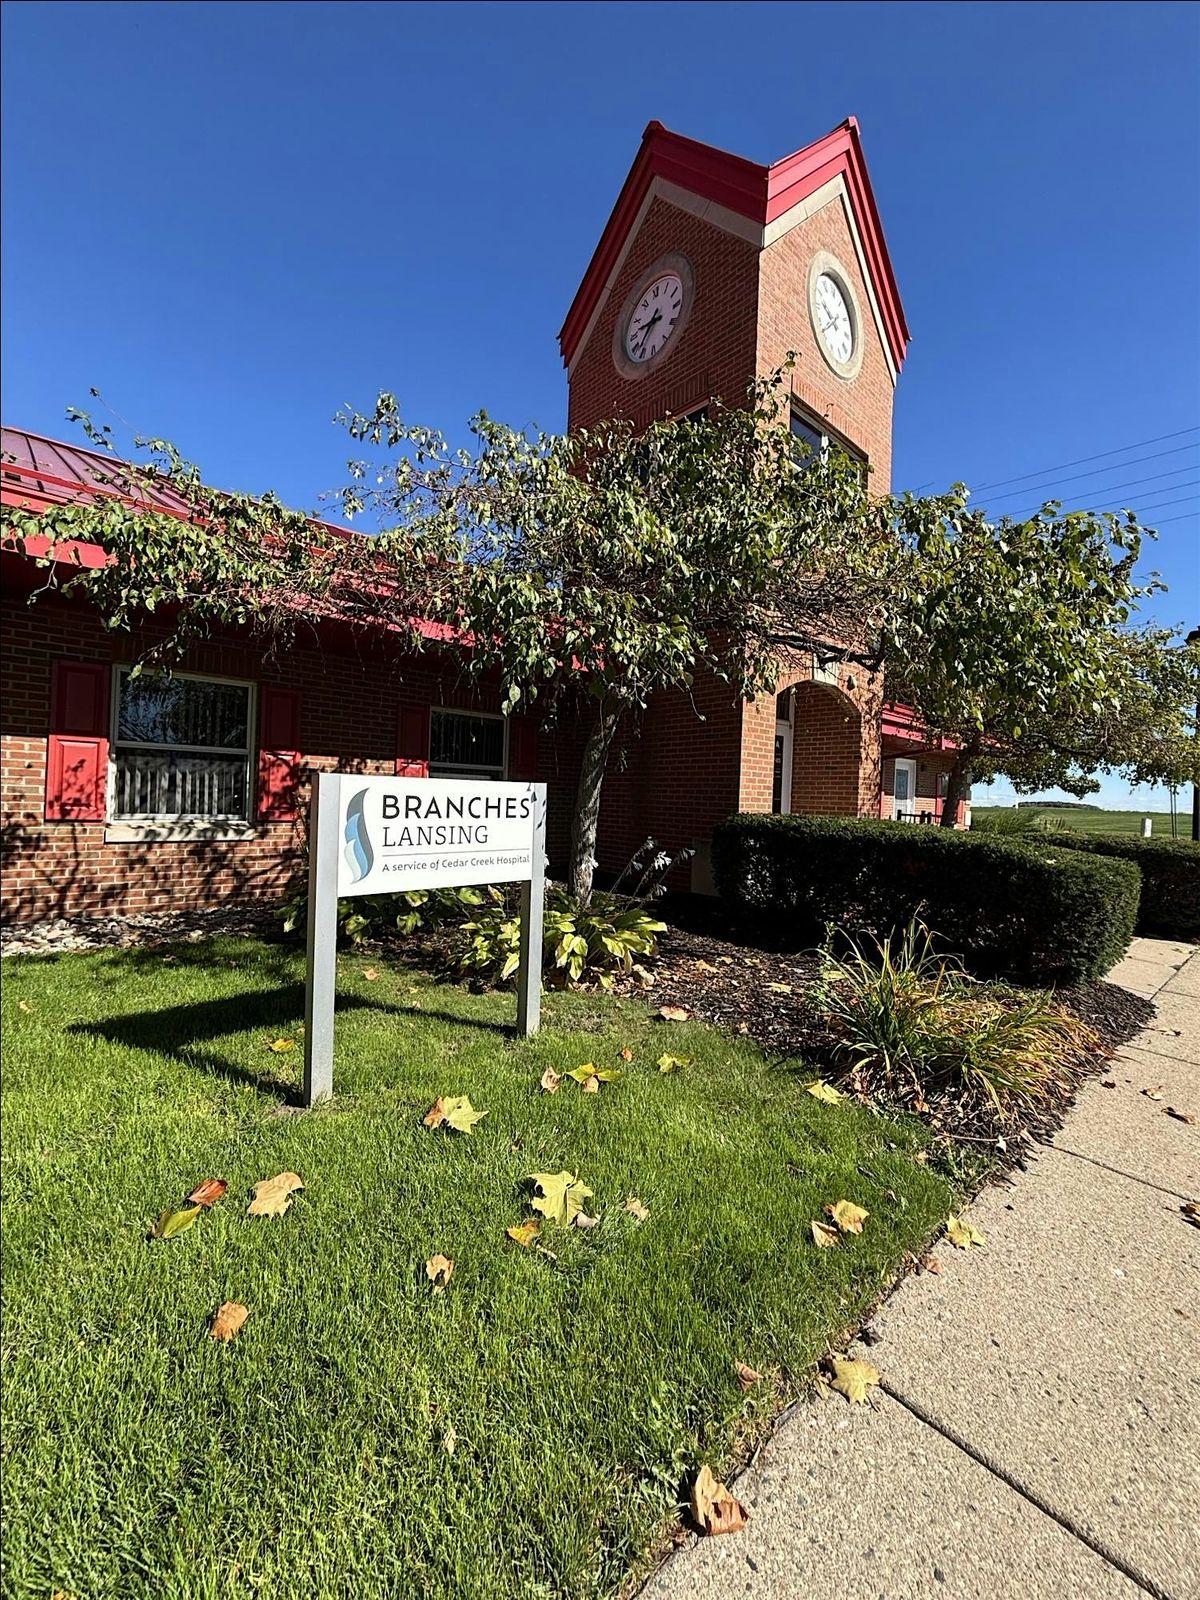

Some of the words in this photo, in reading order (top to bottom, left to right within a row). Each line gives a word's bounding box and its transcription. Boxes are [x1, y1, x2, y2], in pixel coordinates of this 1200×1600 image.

[382, 794, 530, 819] BRANCHES
[382, 825, 488, 847] LANSING
[382, 863, 390, 872] A
[392, 861, 427, 872] service
[430, 859, 440, 870] of
[441, 859, 469, 868] Cedar
[470, 857, 495, 866] Creek
[496, 855, 530, 866] Hospital
